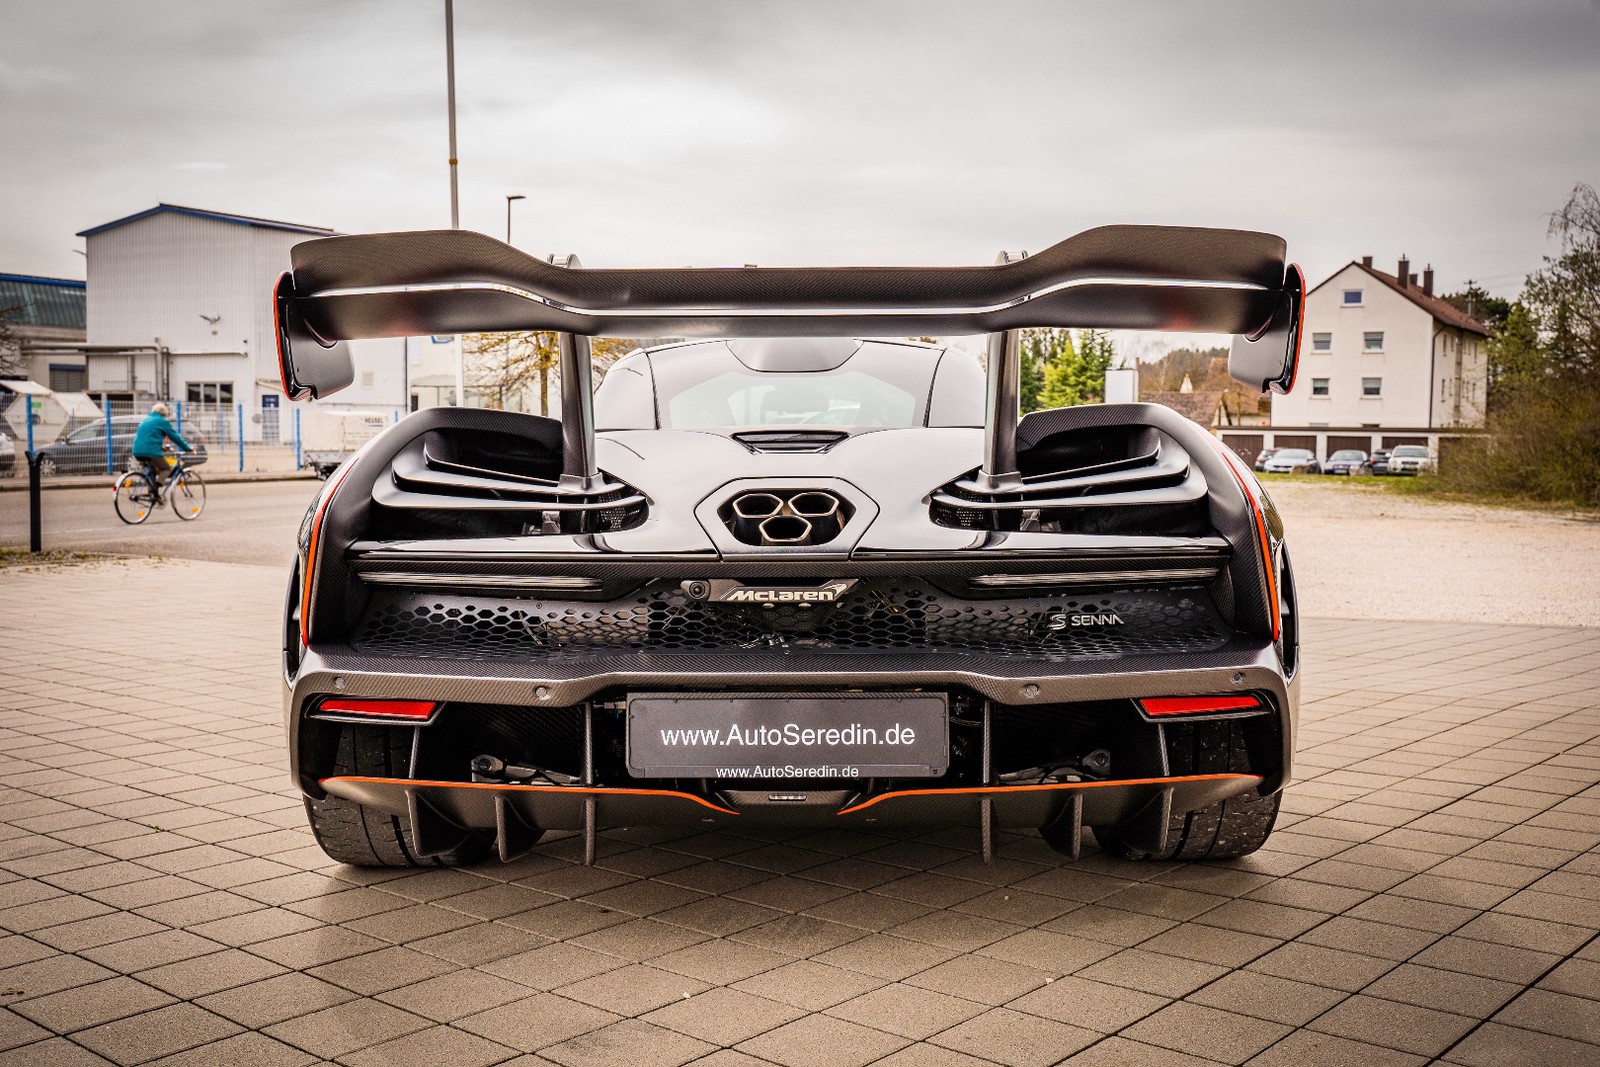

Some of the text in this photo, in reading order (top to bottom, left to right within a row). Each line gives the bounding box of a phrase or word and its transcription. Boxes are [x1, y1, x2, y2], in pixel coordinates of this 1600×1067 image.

[727, 590, 834, 602] McLaren
[1070, 613, 1125, 627] SENNA
[660, 724, 916, 747] www.AutoSeredin.de
[715, 766, 860, 779] www.AutoSeredin.de
